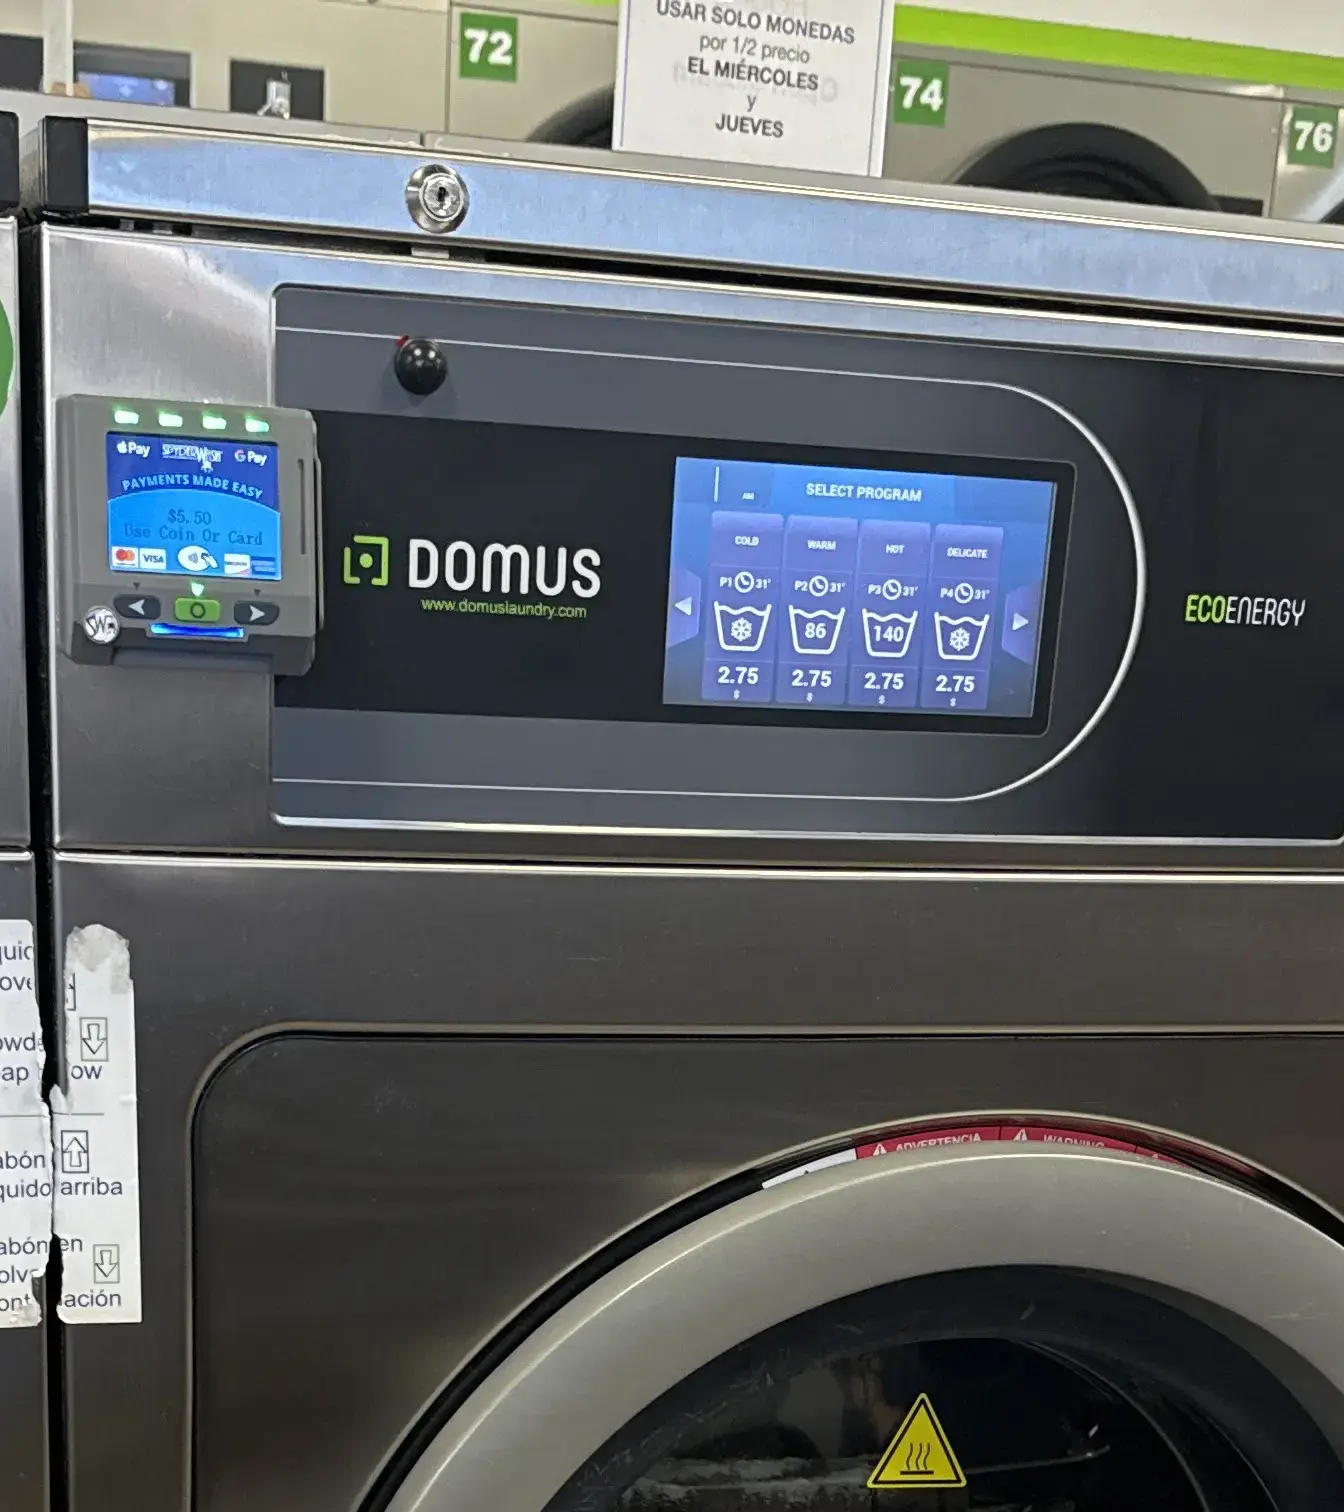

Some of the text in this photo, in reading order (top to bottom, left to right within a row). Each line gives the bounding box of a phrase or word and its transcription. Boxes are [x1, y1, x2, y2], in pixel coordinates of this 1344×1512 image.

[656, 0, 855, 45] USAR SOLO MONEDAS
[464, 29, 513, 65] 72
[700, 35, 810, 63] por 1/2 precio
[687, 56, 709, 76] EL
[714, 58, 819, 91] MIÉRCOLES
[746, 94, 757, 111] y
[899, 76, 945, 111] 74
[715, 113, 784, 138] JUEVES
[1294, 120, 1333, 152] 76
[128, 441, 150, 458] Pay
[247, 451, 267, 466] Pay
[122, 475, 263, 499] PAYMENTS MADE EASY
[806, 482, 922, 502] SELECT PROGRAM
[124, 523, 263, 546] Use Coin Or Card
[734, 535, 760, 546] COLD
[807, 540, 836, 550] WARM
[885, 544, 905, 554] HOT
[947, 547, 988, 558] DELICATE
[142, 553, 164, 564] VISA
[408, 538, 601, 598] DOMUS
[719, 576, 732, 588] P1
[794, 580, 808, 592] P2
[940, 587, 953, 598] P4
[421, 598, 587, 620] www.domuslaundry.com
[1185, 594, 1306, 627] ECOENERGY
[804, 620, 827, 640] 86
[873, 625, 904, 643] 140
[717, 667, 759, 686] 2.75
[791, 669, 832, 689] 2.75
[864, 672, 905, 691] 2.75
[935, 675, 975, 694] 2.75
[60, 1177, 123, 1195] arriba
[59, 1238, 83, 1252] en
